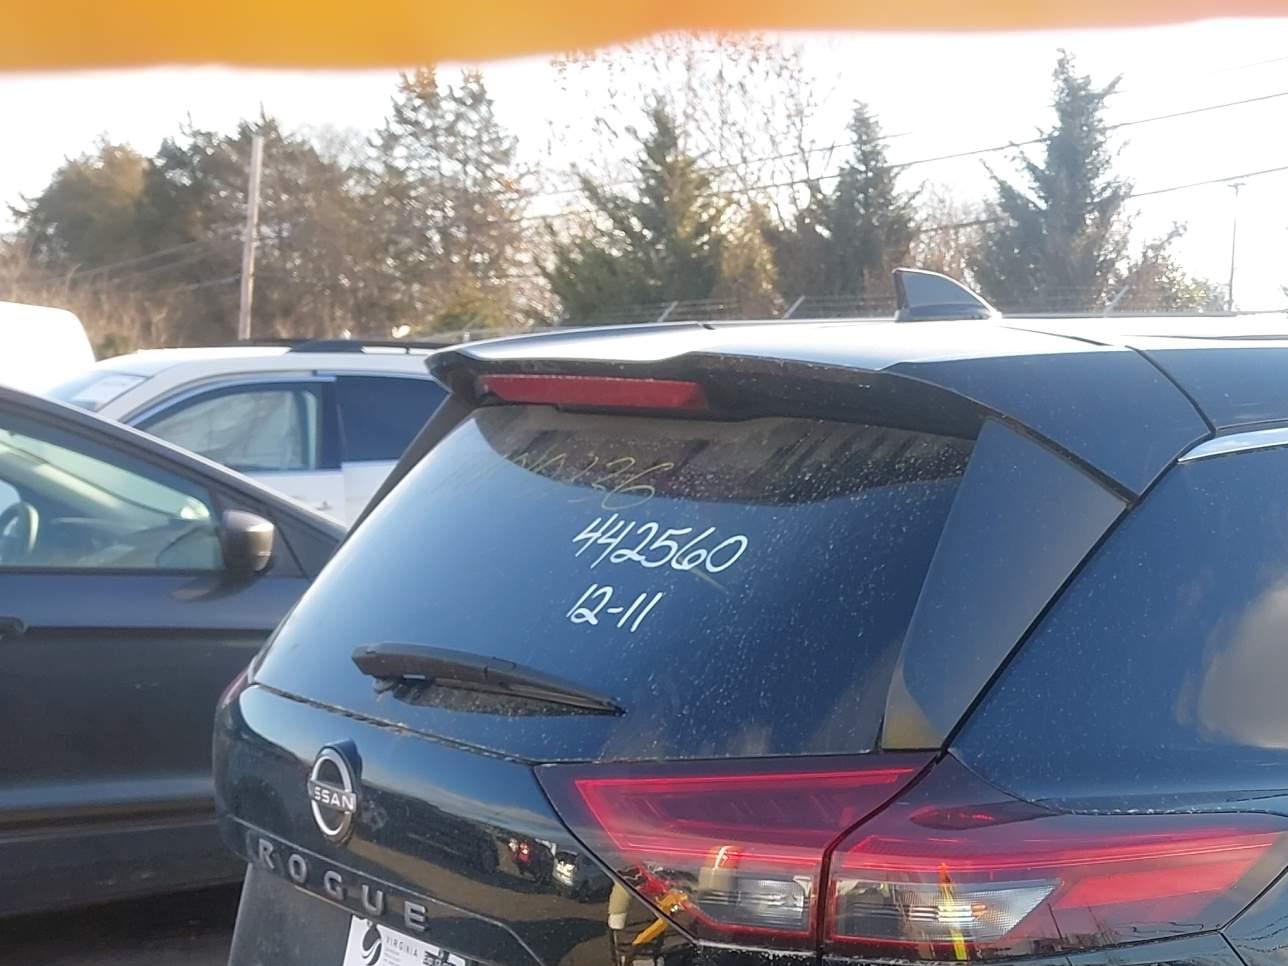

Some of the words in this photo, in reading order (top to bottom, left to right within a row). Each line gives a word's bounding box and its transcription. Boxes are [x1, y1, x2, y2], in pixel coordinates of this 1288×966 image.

[572, 513, 748, 573] 442560
[566, 583, 663, 632] 12-11
[258, 837, 428, 932] ROGUE
